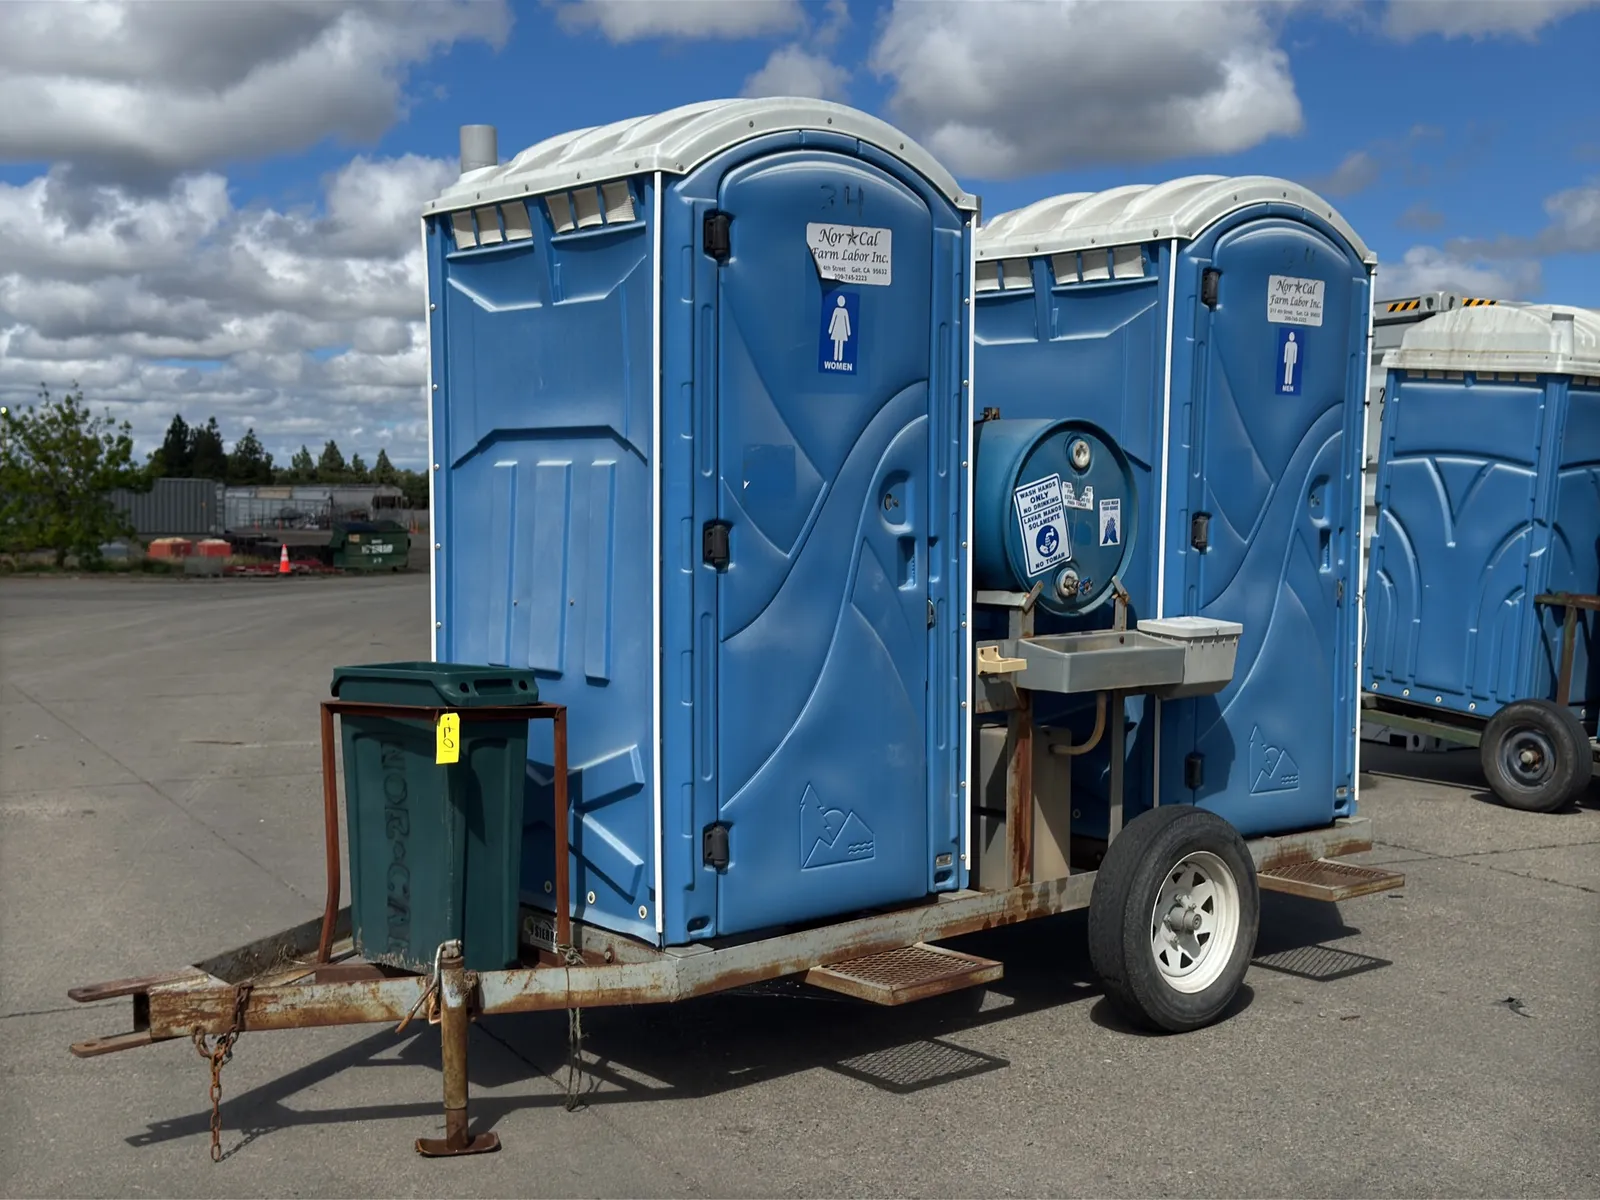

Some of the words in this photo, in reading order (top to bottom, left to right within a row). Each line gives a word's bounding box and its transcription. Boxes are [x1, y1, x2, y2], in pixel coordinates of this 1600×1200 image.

[818, 227, 844, 247] Nor
[860, 231, 881, 246] Cal
[811, 247, 839, 260] Farm
[842, 249, 870, 261] Labor
[872, 251, 889, 263] Inc.
[1276, 279, 1294, 295] Nor
[1302, 282, 1318, 295] Cal
[1269, 294, 1289, 306] Farm
[1290, 296, 1311, 307] Labor
[1310, 299, 1322, 309] Inc.
[824, 361, 853, 371] WOMEN
[1019, 489, 1036, 499] WASH
[1037, 481, 1056, 493] HANDS
[1030, 491, 1049, 504] ONLY
[1033, 496, 1059, 511] DRINKING
[1023, 513, 1042, 525] LAVAR
[1043, 505, 1062, 517] MANOS
[1028, 513, 1060, 531] SOLAMENTE
[1035, 561, 1045, 569] NO
[1046, 552, 1065, 564] TOMAR
